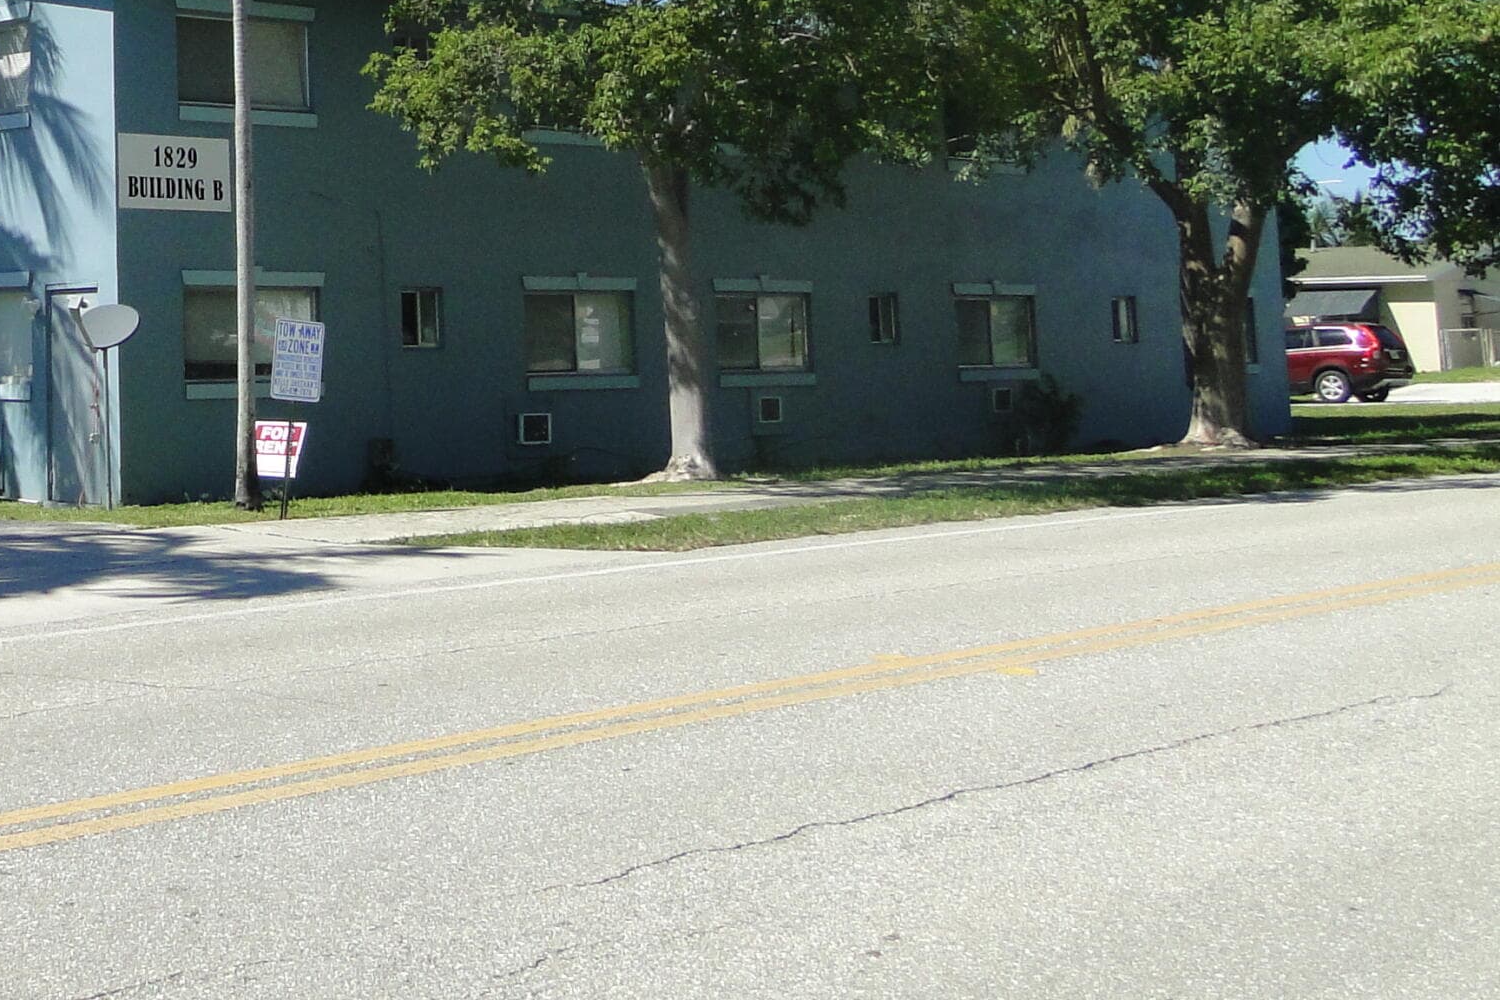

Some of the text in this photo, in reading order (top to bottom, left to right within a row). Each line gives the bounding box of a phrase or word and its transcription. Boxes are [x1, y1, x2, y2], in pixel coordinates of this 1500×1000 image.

[153, 145, 198, 169] 1829
[128, 176, 224, 201] BUILDING B
[287, 339, 309, 355] ZONE
[260, 426, 296, 440] FOR
